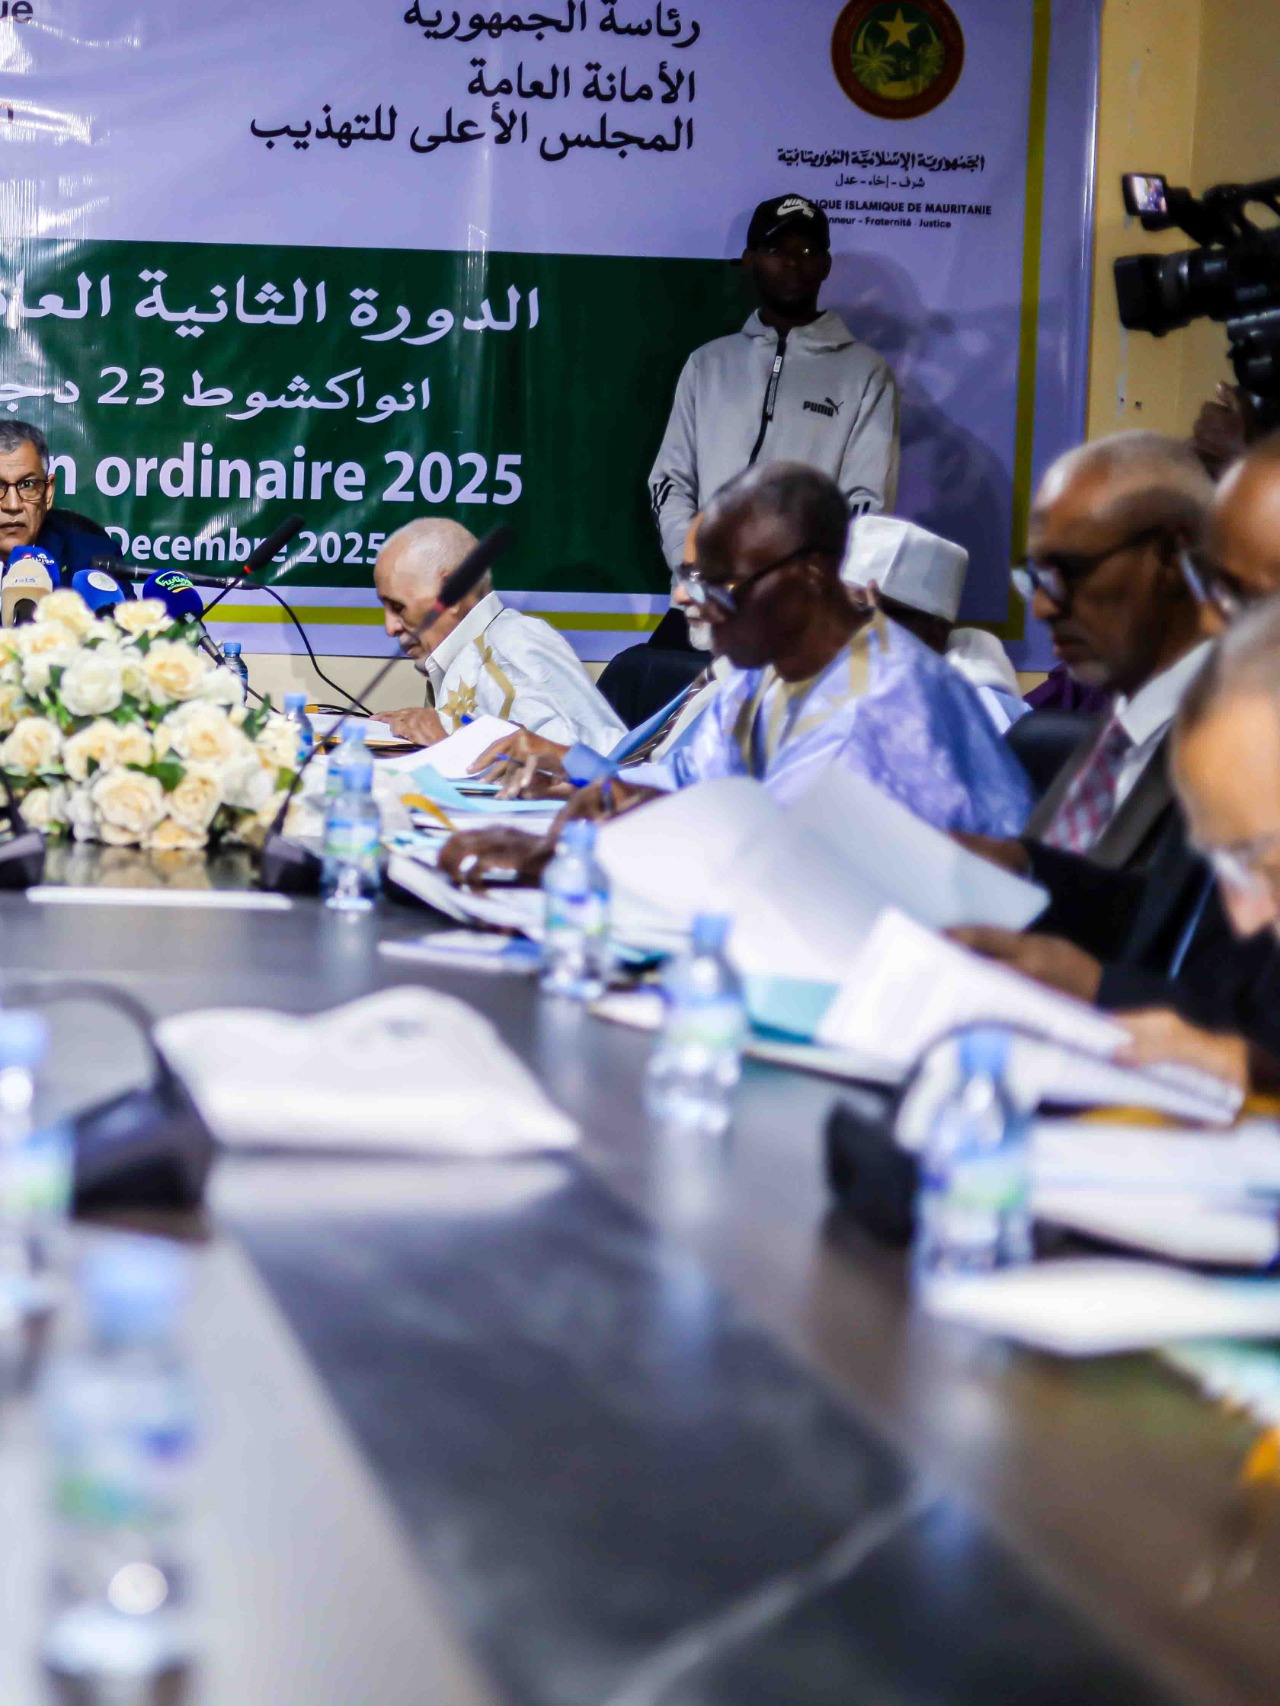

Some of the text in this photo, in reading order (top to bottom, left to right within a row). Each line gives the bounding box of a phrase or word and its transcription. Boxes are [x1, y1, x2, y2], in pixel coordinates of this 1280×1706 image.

[600, 0, 700, 48] رئاسة
[468, 58, 695, 103] الأمانة العامة
[251, 102, 693, 161] المجلس الأعلى للتهذيب
[835, 173, 858, 188] عدل
[899, 176, 926, 190] شرف
[828, 216, 855, 225] nneur
[865, 216, 912, 227] Fraternité
[919, 218, 952, 229] Justice
[845, 200, 905, 213] ISLAMIQUE
[907, 203, 922, 213] DE
[925, 204, 992, 216] MAURITANIE
[134, 269, 326, 338] الثانية
[350, 285, 539, 345] الدورة
[97, 366, 165, 405] 23
[183, 367, 430, 423] انواكشوط
[95, 442, 365, 500] ordinaire
[382, 451, 522, 505] 2025
[297, 531, 386, 564] 2025
